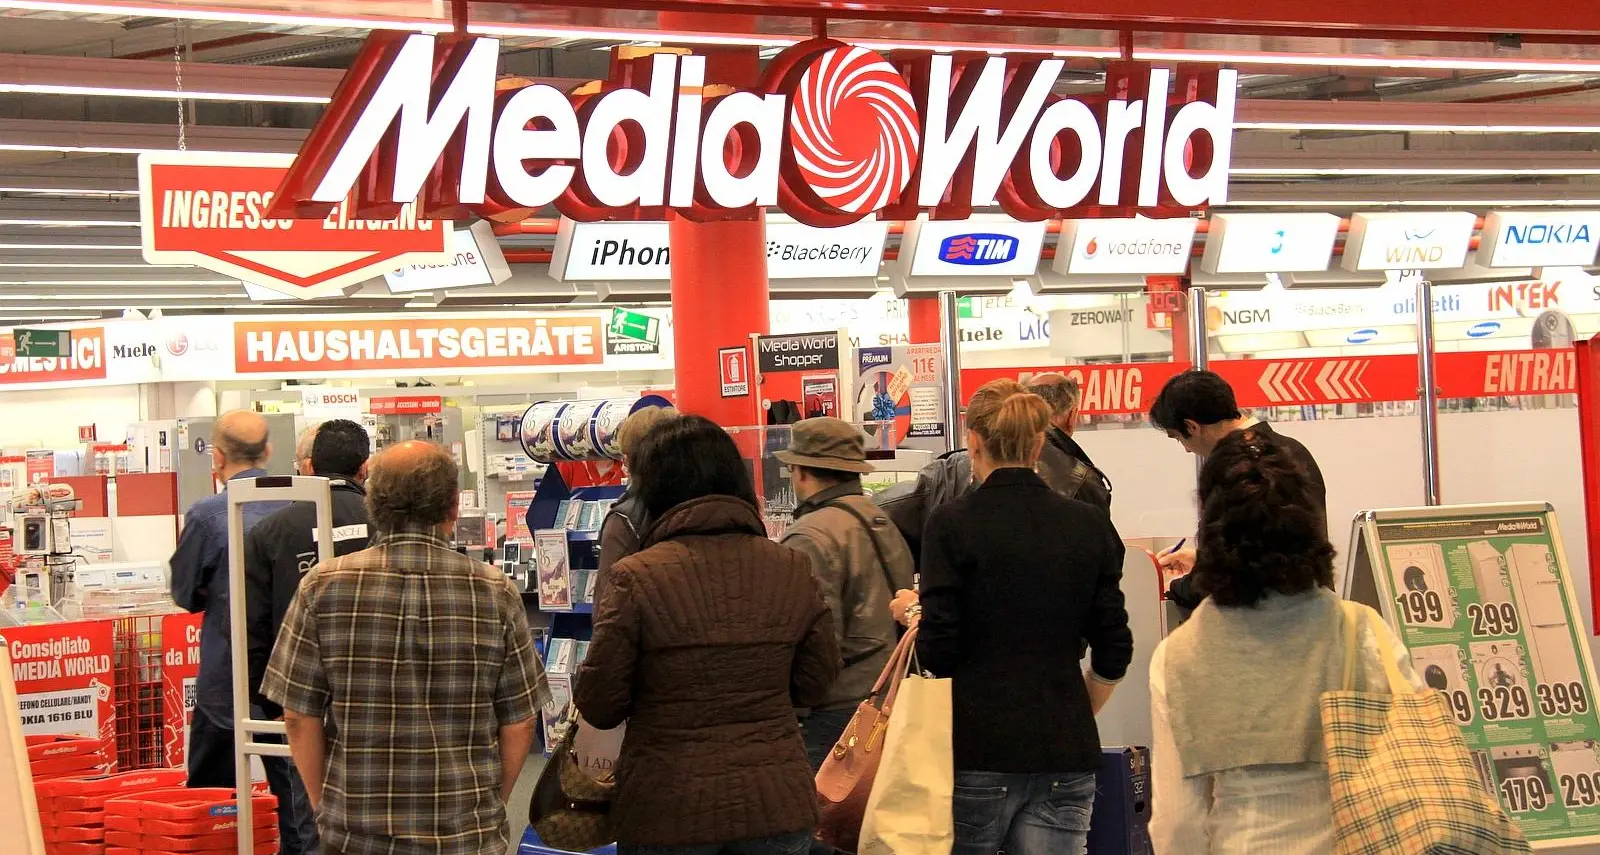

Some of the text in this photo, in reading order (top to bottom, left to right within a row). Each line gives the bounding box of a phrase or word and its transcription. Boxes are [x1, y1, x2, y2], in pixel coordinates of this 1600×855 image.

[312, 33, 1238, 209] Media World
[161, 189, 293, 230] INGRESS
[1505, 224, 1591, 244] NOKIA
[590, 239, 670, 266] iPhon
[781, 241, 873, 264] BlackBerry
[974, 238, 1013, 260] TIM
[1107, 237, 1182, 257] vodafone
[1385, 245, 1444, 263] WIND
[1393, 294, 1460, 315] olietti
[1488, 281, 1562, 311] INTEK
[1223, 308, 1271, 325] NGM
[247, 320, 594, 363] HAUSHALTSGERÄTE
[613, 343, 654, 352] ARISTON
[761, 336, 836, 353] Media World
[879, 333, 908, 346] SHA
[113, 342, 157, 359] Miele
[774, 354, 823, 367] Shopper
[912, 357, 935, 374] 11€
[1484, 352, 1578, 394] ENTRAT
[322, 394, 358, 404] BOSCH
[1396, 591, 1444, 624] 199
[1468, 603, 1520, 636] 299
[185, 624, 201, 643] Co
[11, 636, 91, 660] Consigliato
[165, 646, 200, 666] da M
[13, 654, 111, 682] MEDIA WORLD
[19, 700, 39, 710] EFONO
[1478, 687, 1530, 720] 329
[1537, 682, 1588, 716] 399
[47, 711, 72, 723] 1616
[74, 709, 93, 719] BLU
[1501, 777, 1546, 811] 179
